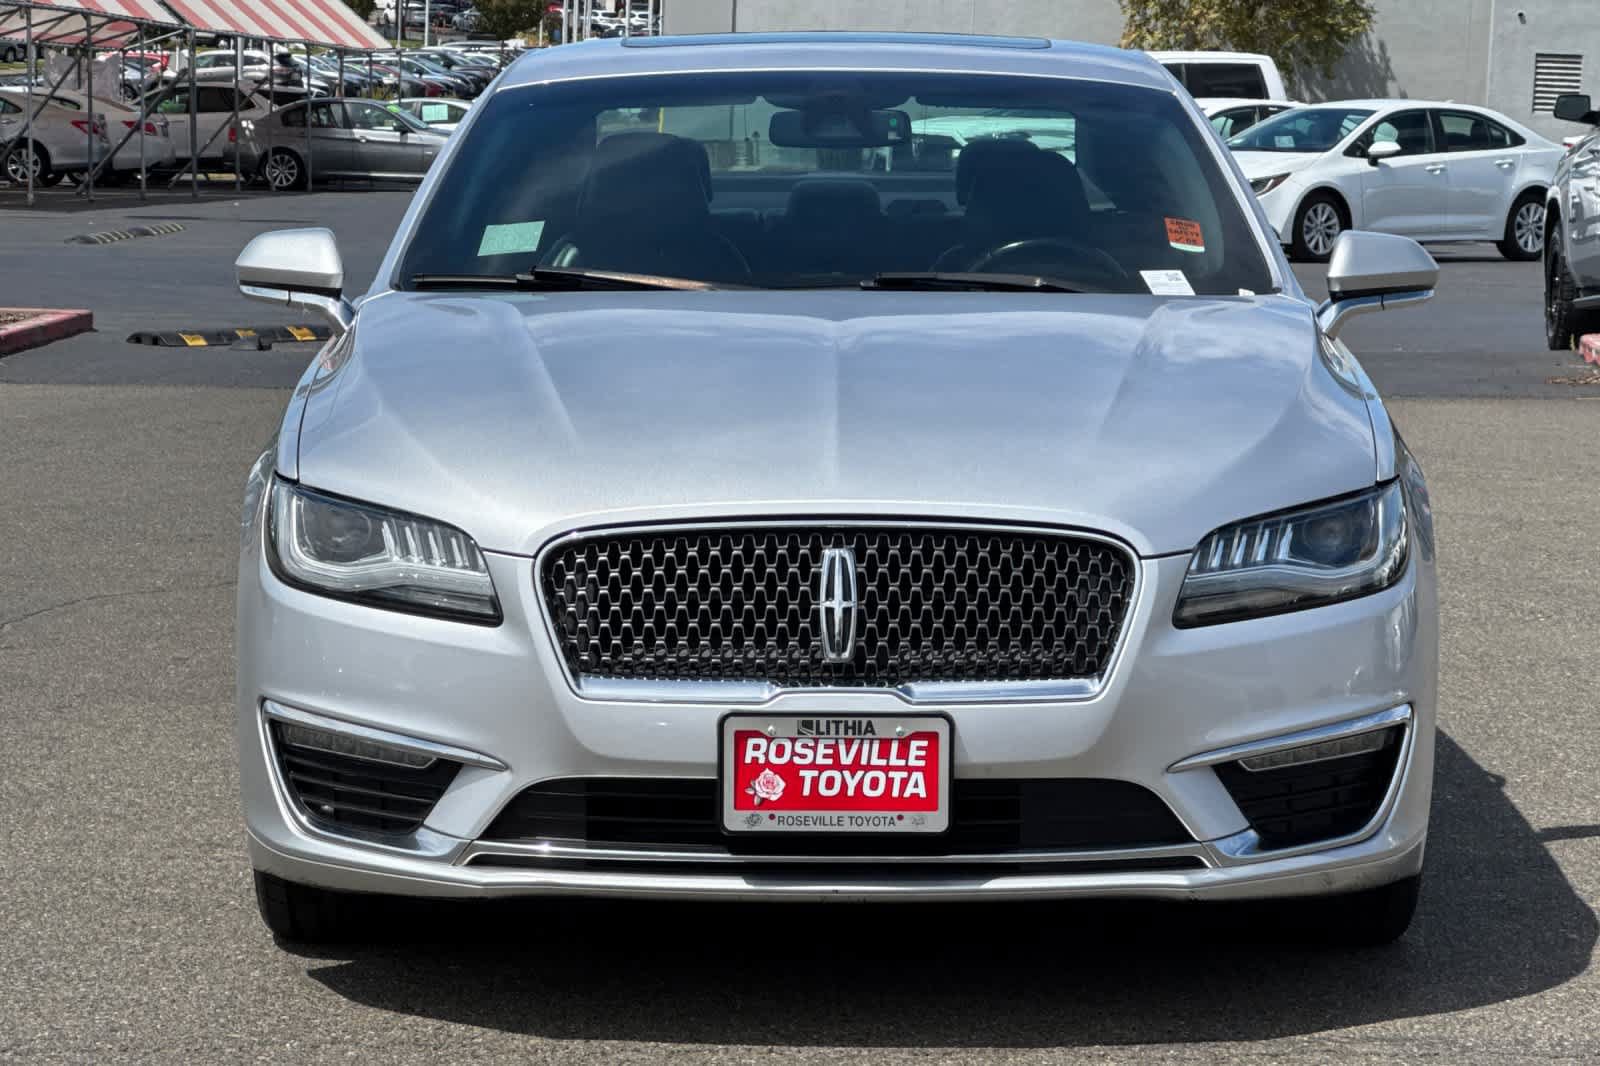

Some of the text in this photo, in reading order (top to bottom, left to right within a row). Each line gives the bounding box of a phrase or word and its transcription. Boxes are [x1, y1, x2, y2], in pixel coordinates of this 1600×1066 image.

[816, 720, 876, 736] LITHIA
[744, 738, 928, 766] ROSEVILLE
[799, 770, 927, 798] TOYOTA
[777, 813, 896, 827] ROSEVILLE TOYOTA
